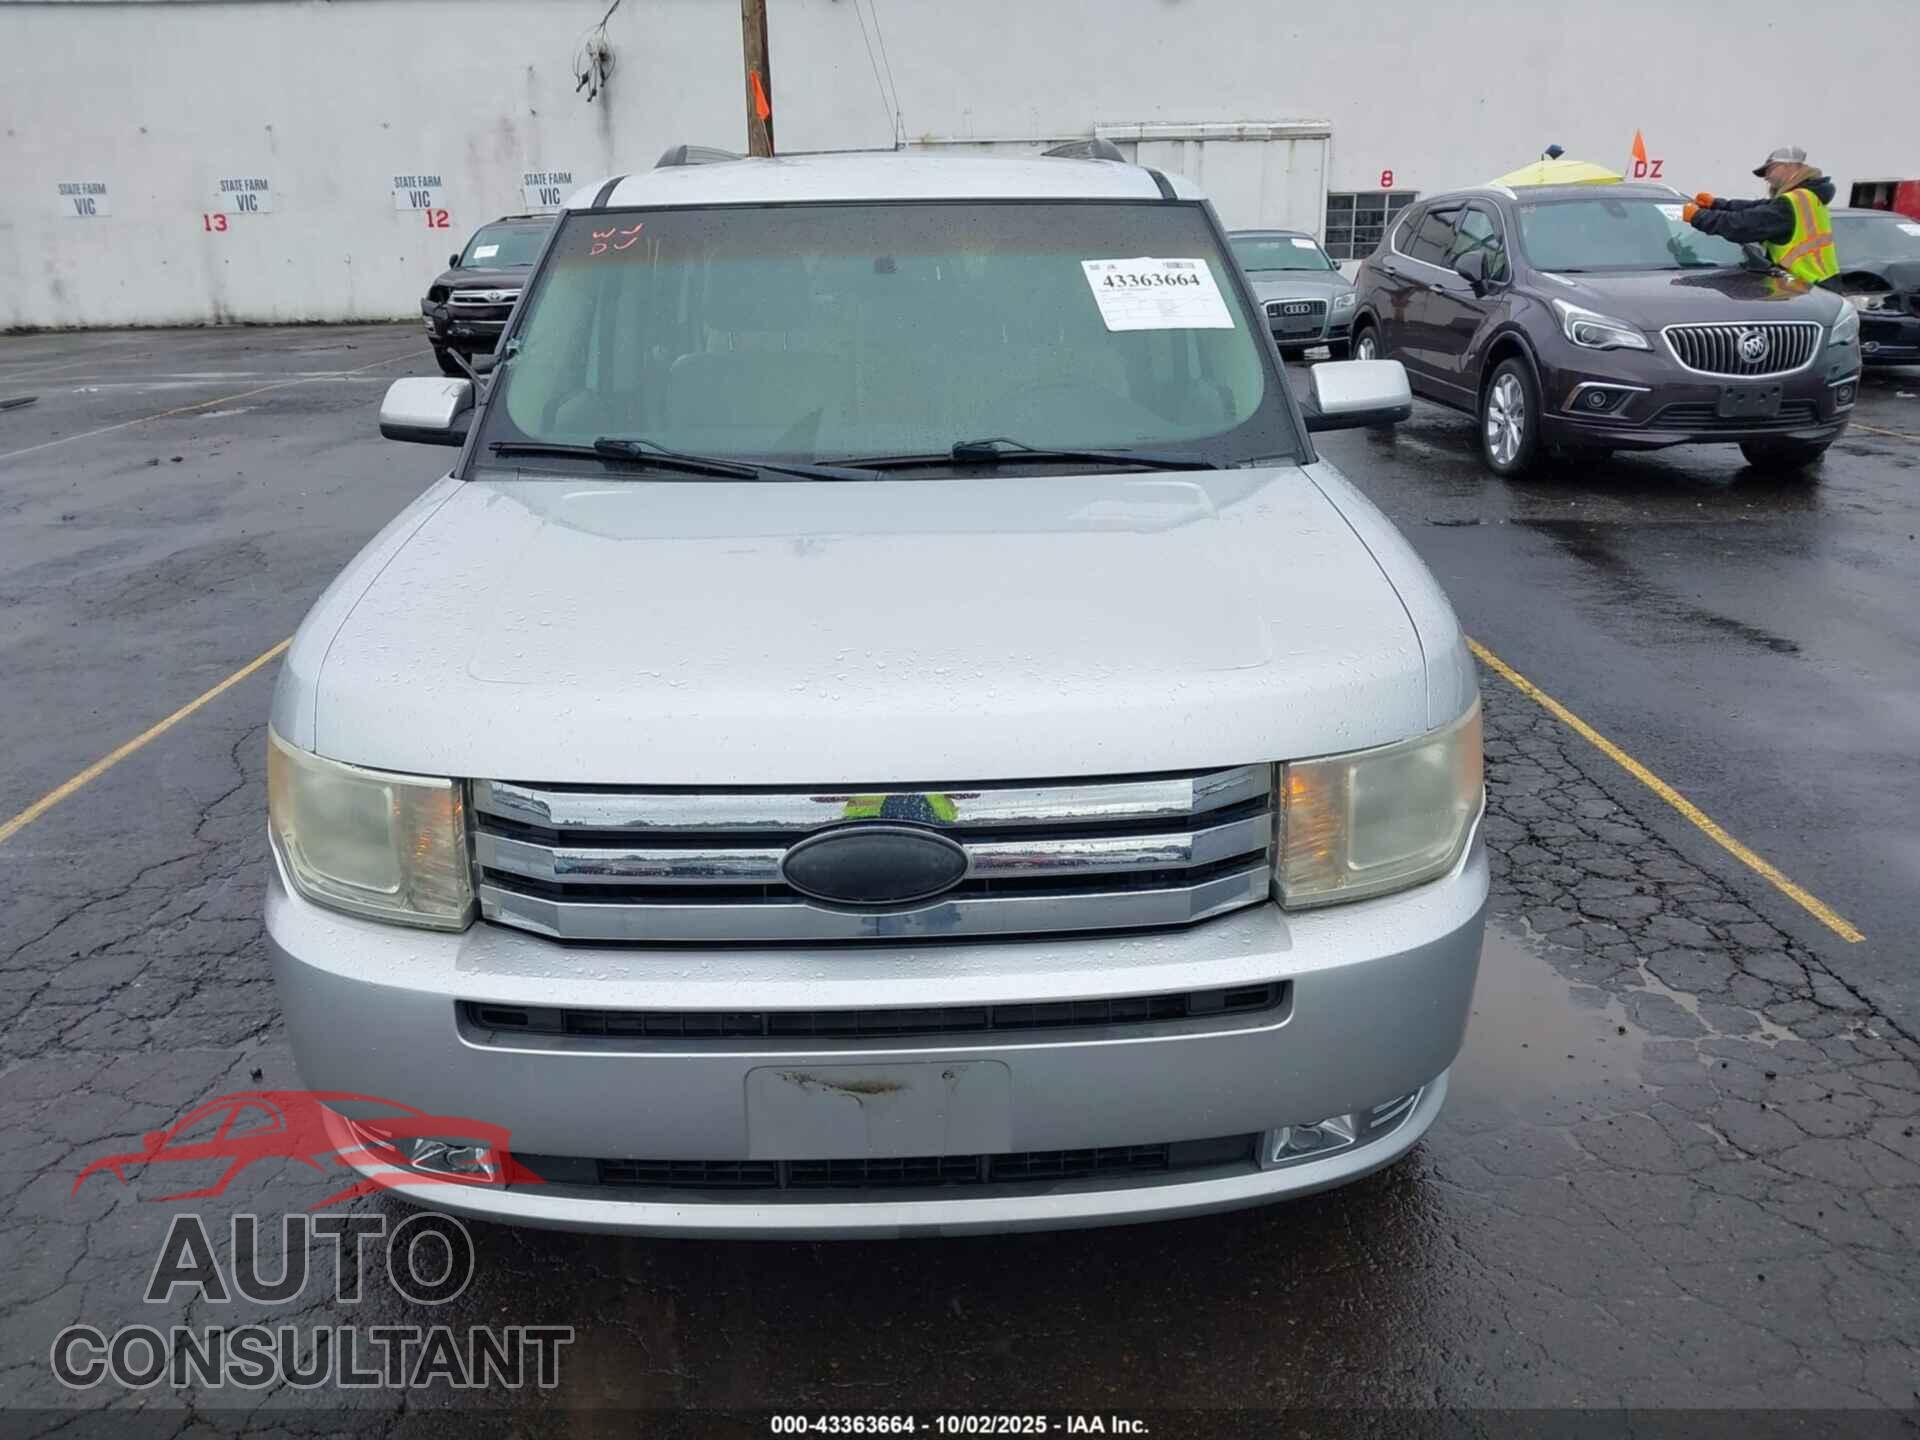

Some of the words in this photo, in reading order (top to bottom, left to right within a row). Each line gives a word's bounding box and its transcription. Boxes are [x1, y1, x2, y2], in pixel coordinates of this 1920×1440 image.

[220, 180, 243, 192] STATE
[244, 179, 269, 191] FARM
[394, 176, 417, 188] STATE
[418, 175, 442, 187] FARM
[525, 173, 547, 186] STATE
[549, 172, 572, 184] FARM
[1381, 170, 1393, 187] 8
[58, 183, 81, 195] STATE
[82, 183, 106, 194] FARM
[539, 187, 560, 205] VIC
[73, 198, 96, 215] VIC
[235, 194, 258, 212] VIC
[409, 190, 430, 208] VIC
[203, 213, 228, 232] 13
[426, 209, 449, 228] 12
[1103, 273, 1200, 288] 43363664
